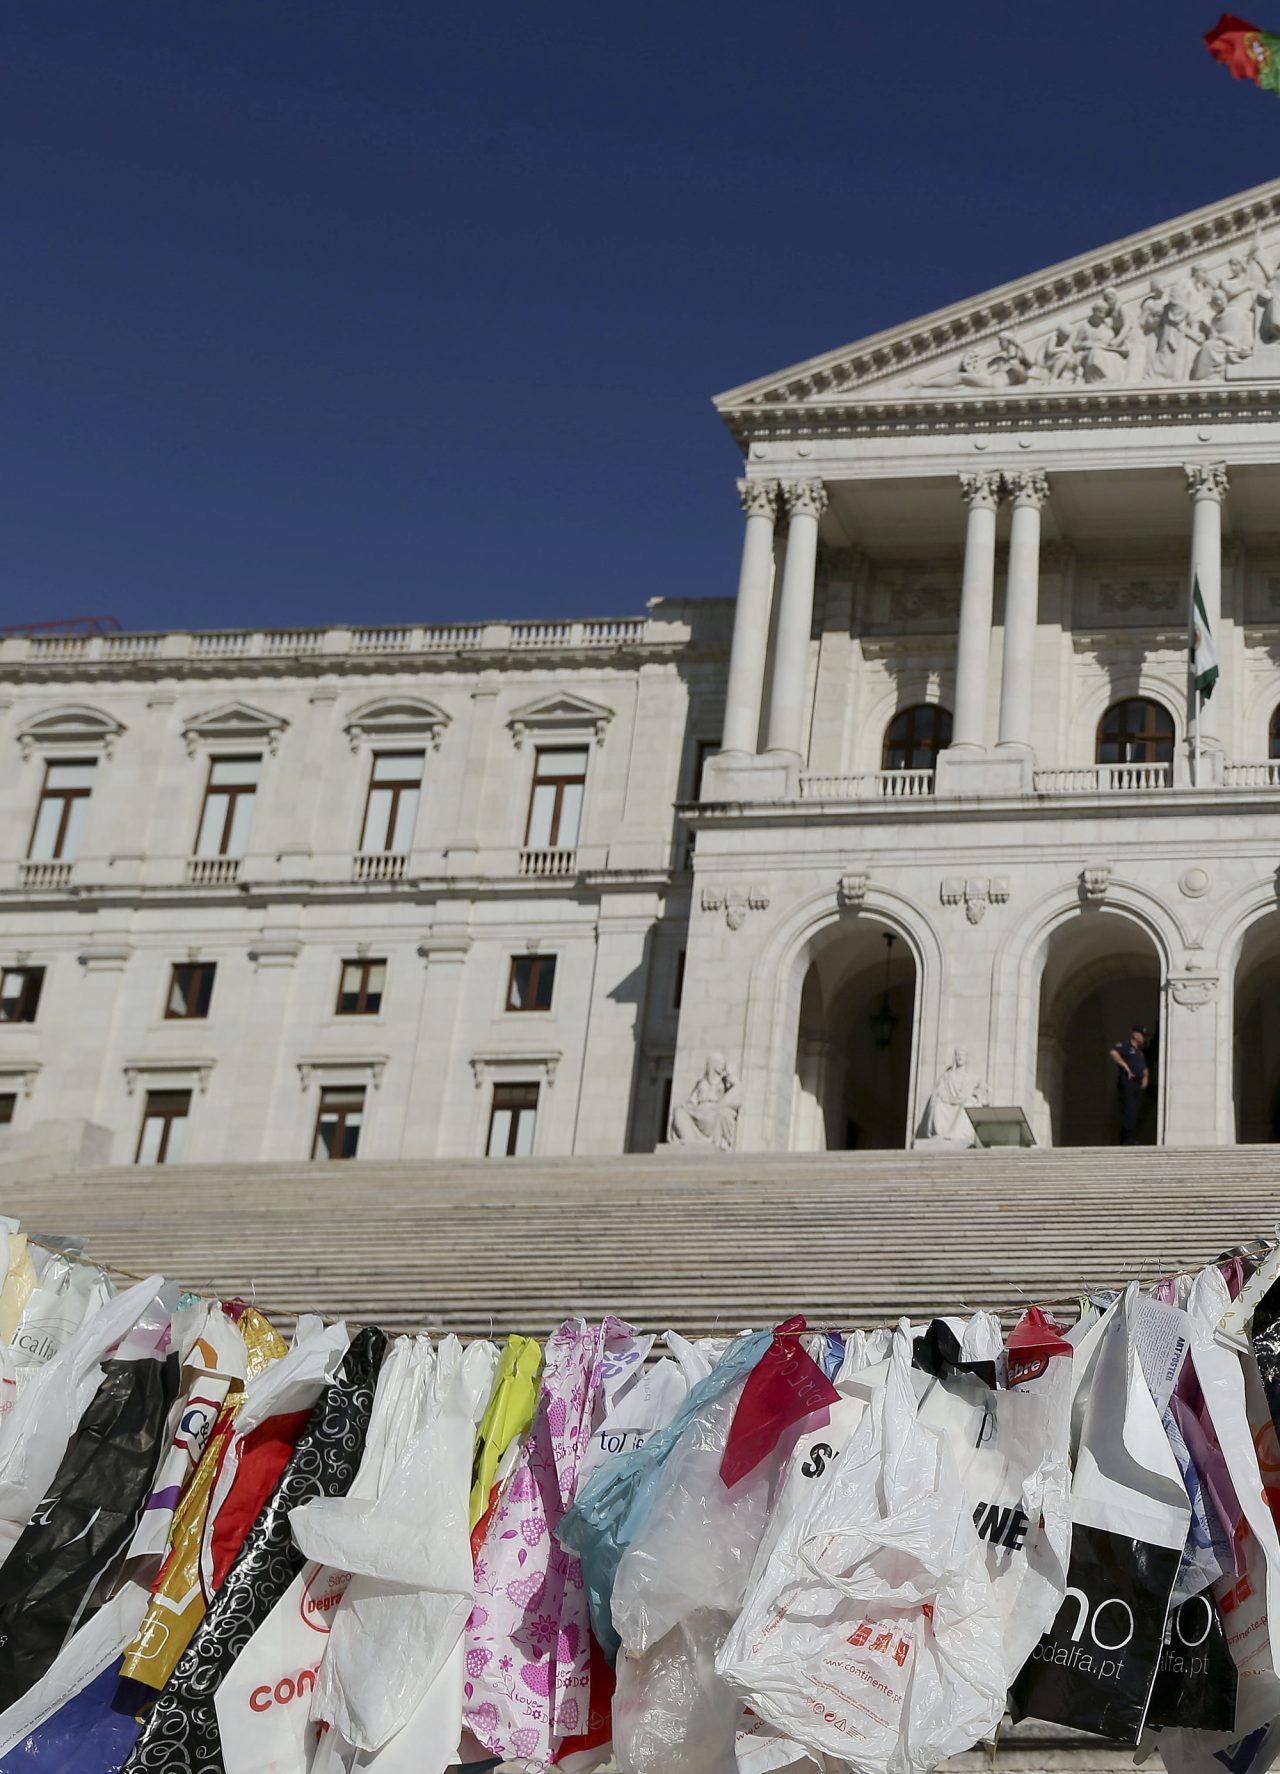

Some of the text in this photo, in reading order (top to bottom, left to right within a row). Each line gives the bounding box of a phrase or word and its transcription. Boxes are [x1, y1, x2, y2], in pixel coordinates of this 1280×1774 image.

[1165, 1336, 1186, 1382] ART POSTER
[249, 1664, 321, 1713] con
